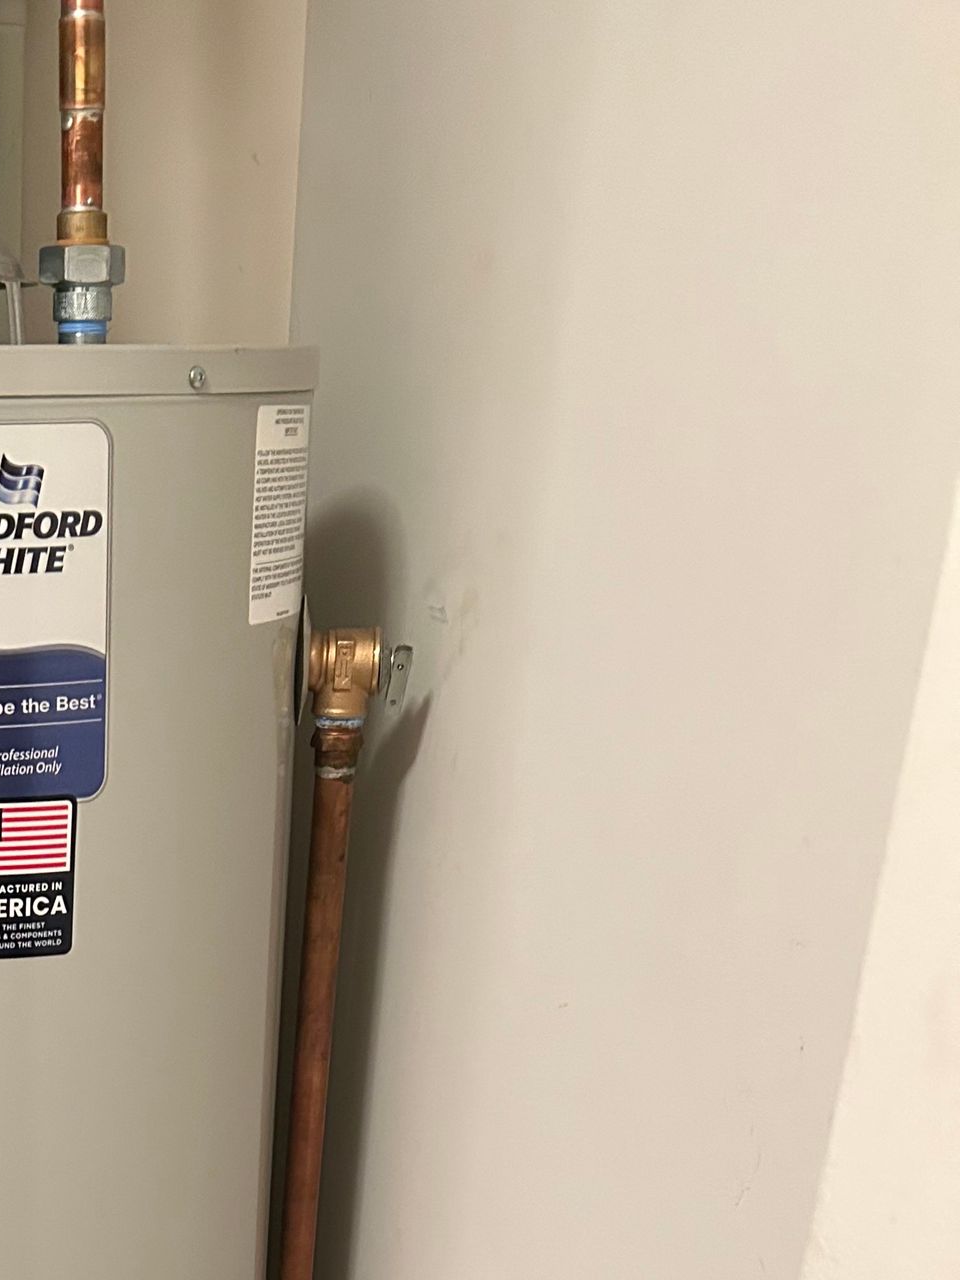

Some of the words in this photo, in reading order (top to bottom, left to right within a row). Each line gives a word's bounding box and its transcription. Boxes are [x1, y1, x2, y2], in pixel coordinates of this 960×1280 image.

[21, 698, 49, 713] the
[57, 695, 95, 711] Best
[36, 762, 62, 775] Only
[52, 882, 62, 891] IN
[19, 922, 45, 930] FINEST
[11, 930, 62, 939] COMPONENTS
[34, 939, 61, 947] WORLD
